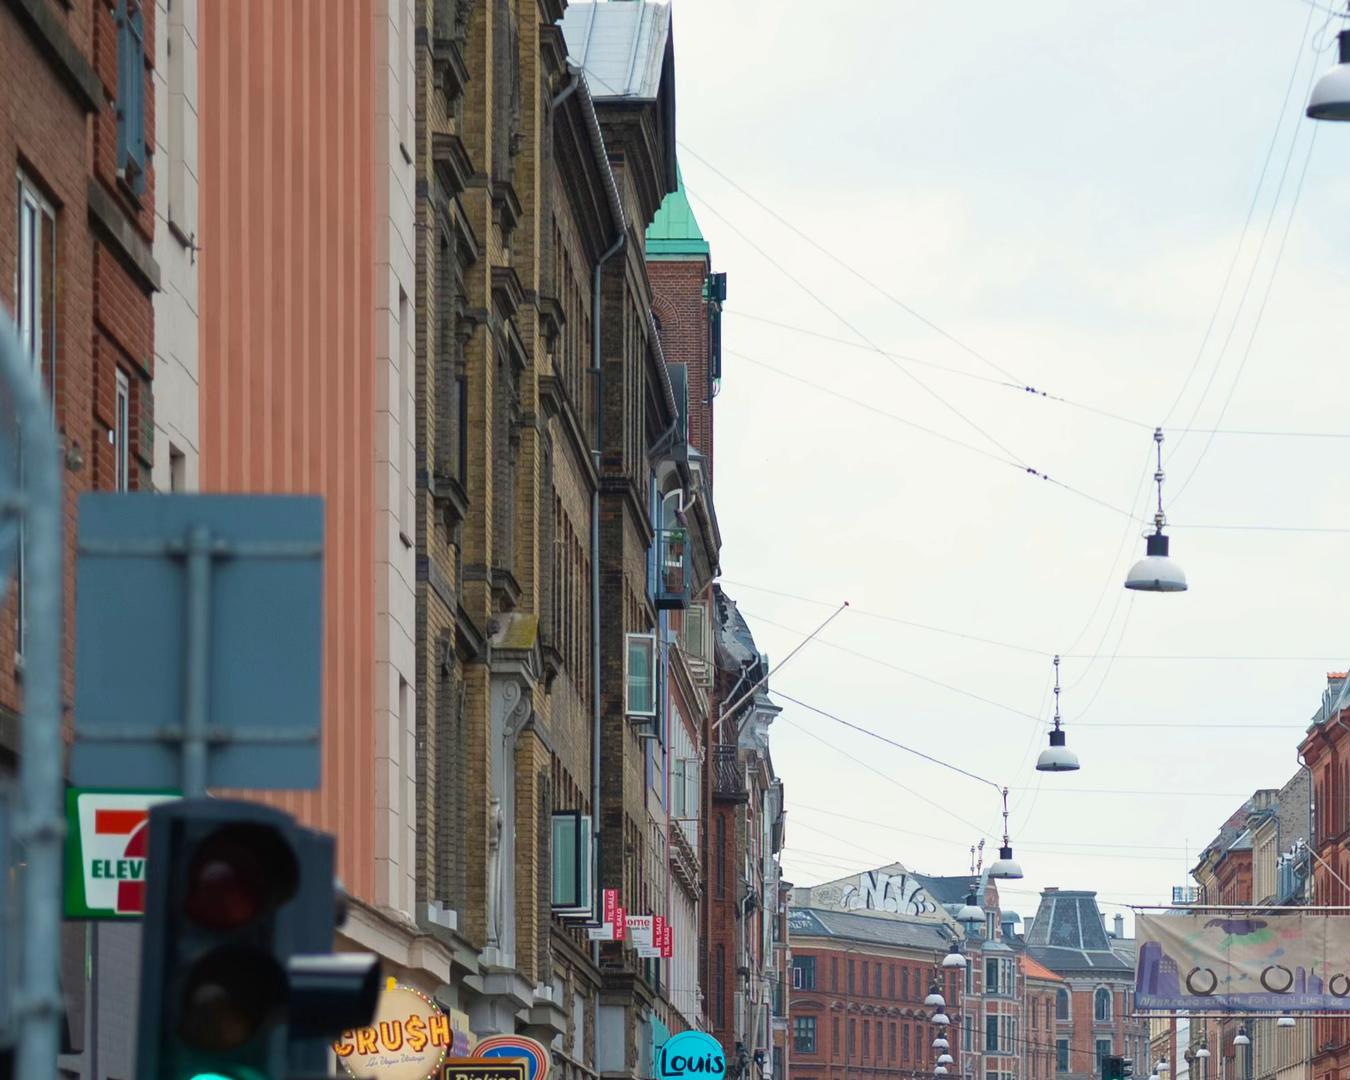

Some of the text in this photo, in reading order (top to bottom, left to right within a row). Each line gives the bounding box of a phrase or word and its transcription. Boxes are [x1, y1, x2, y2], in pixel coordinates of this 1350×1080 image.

[91, 859, 146, 879] ELEV
[627, 919, 650, 927] ome
[661, 1047, 724, 1077] Louis
